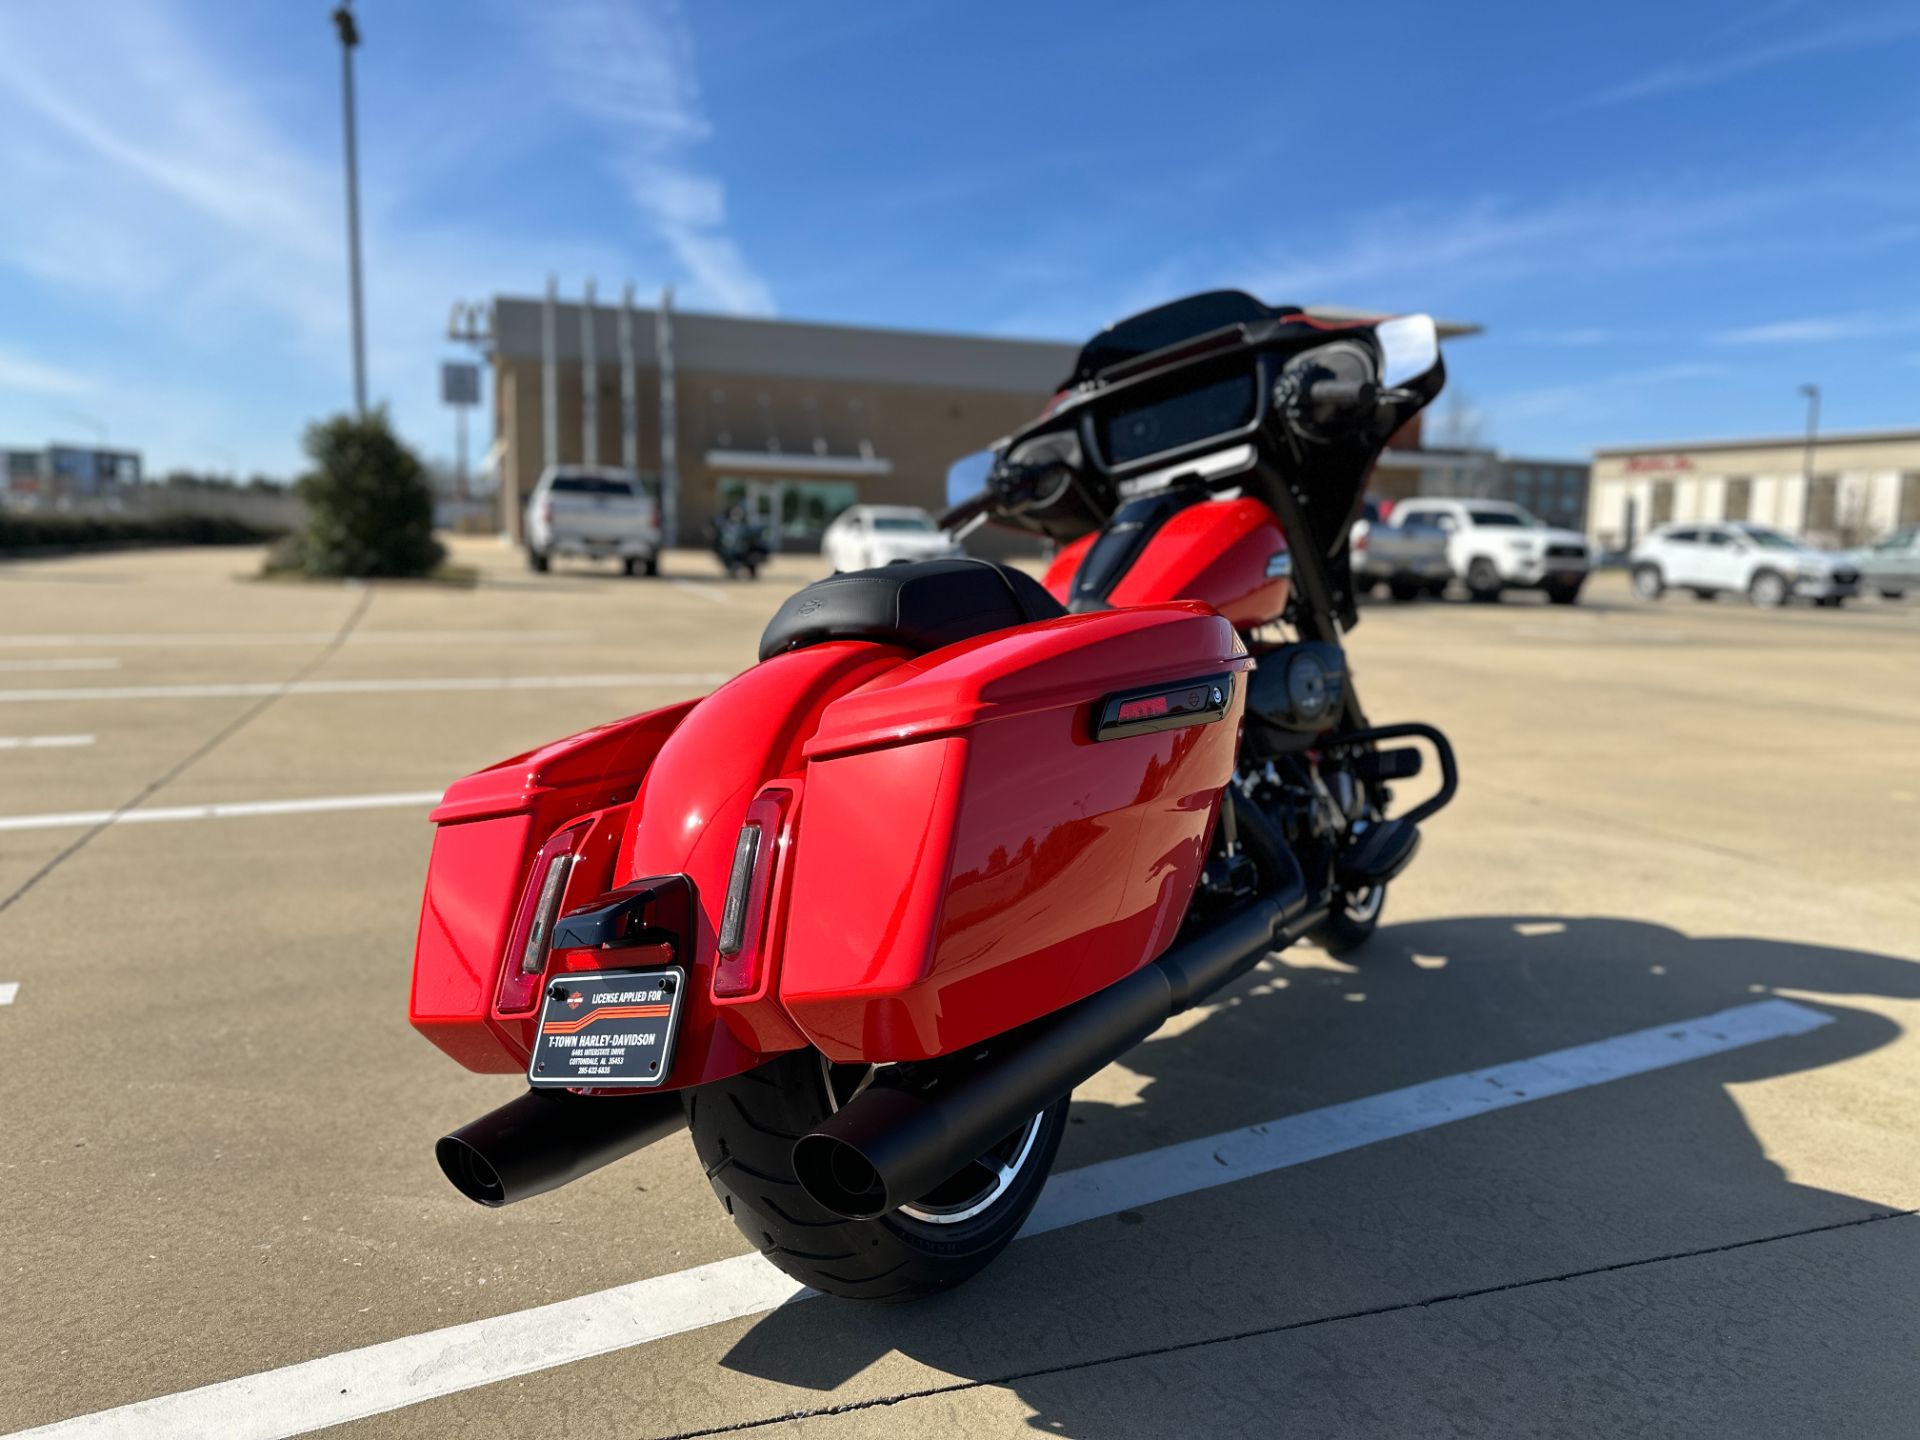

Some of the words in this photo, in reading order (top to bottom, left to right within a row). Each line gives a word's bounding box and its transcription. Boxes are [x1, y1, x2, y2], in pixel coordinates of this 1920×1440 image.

[592, 993, 619, 1003] LICENSE
[619, 991, 646, 1002] APPLIED
[648, 990, 663, 1001] FOR
[549, 1035, 577, 1047] T-TOWN
[579, 1033, 656, 1047] HARLEY-DAVIDSON
[584, 1048, 610, 1056] INTERSTATE
